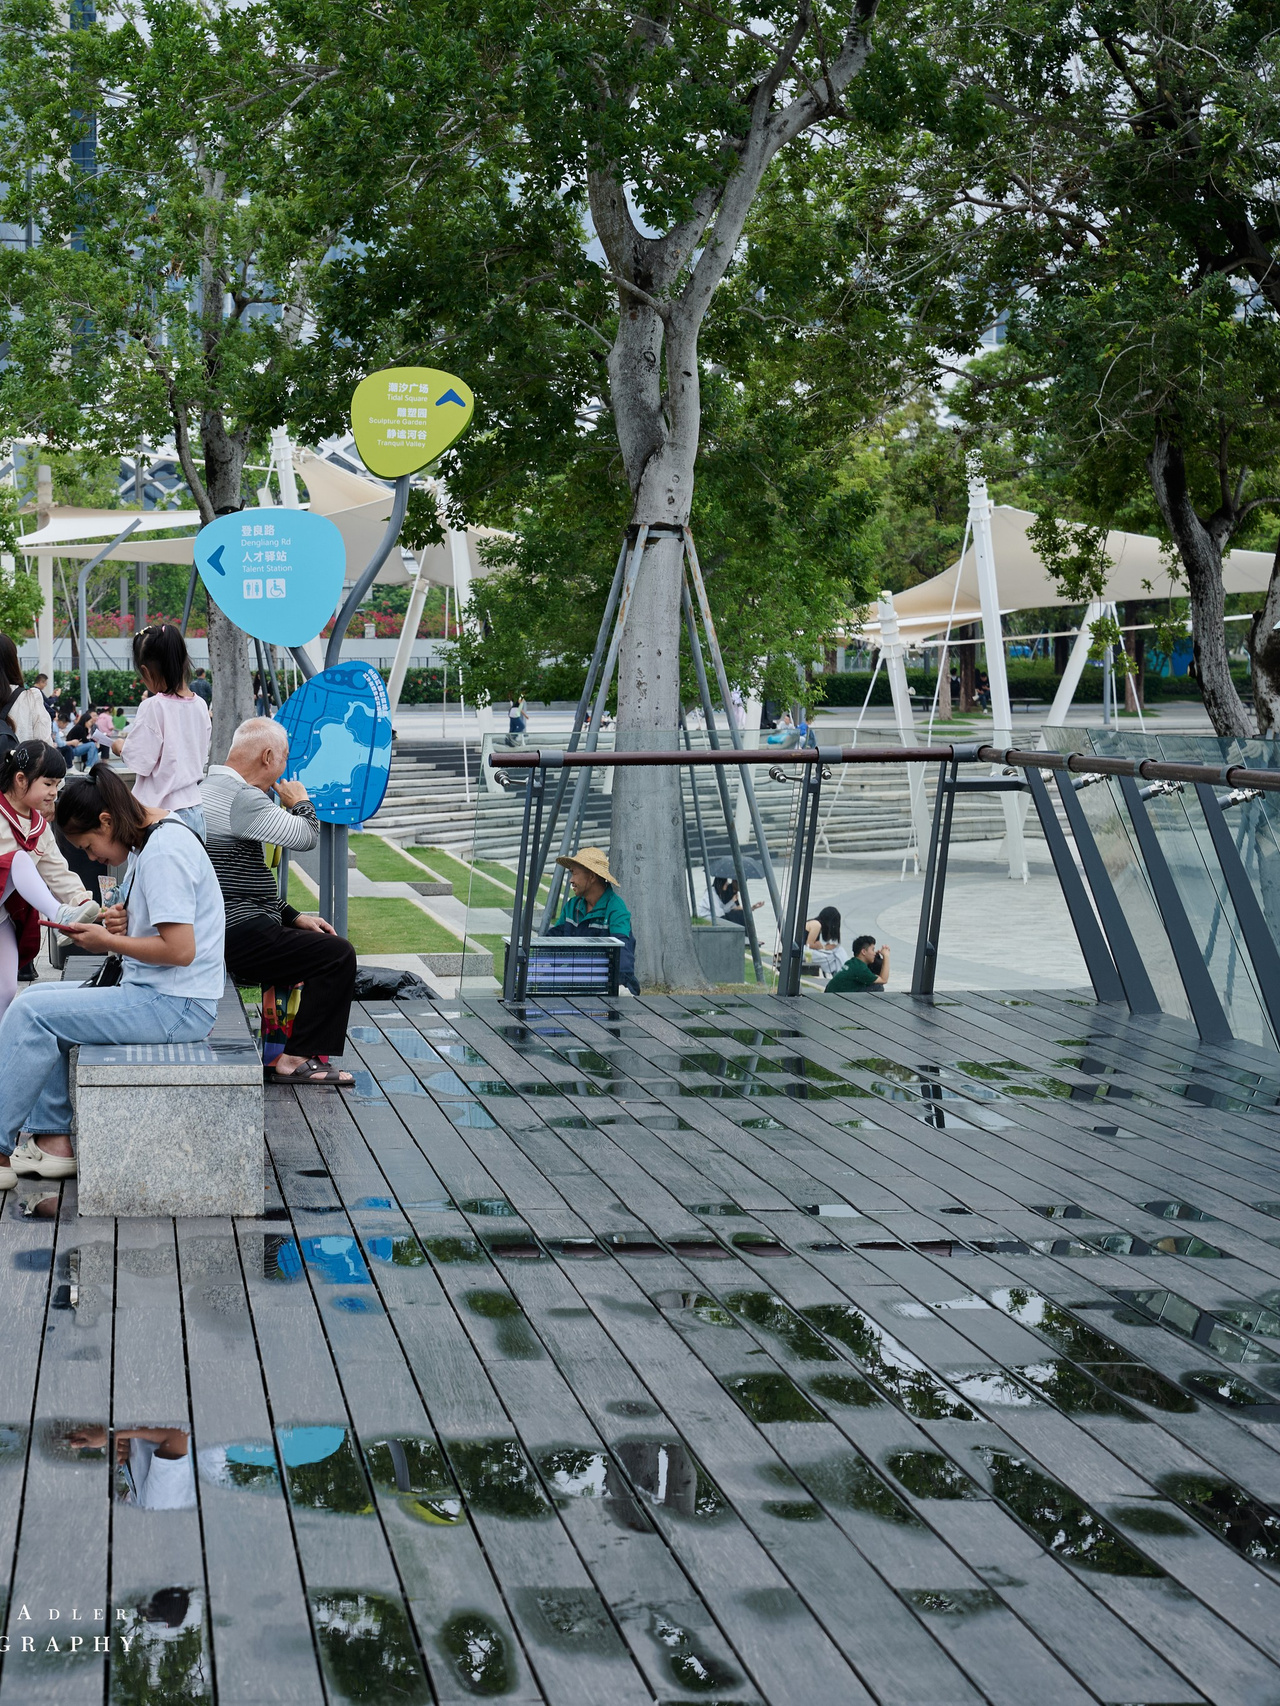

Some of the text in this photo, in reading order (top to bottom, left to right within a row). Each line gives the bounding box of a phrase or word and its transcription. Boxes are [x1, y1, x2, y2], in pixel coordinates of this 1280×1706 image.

[388, 382, 429, 394] 潮汐广场
[397, 407, 427, 418] 雕塑园
[368, 417, 427, 426] Sculpture Garden
[377, 439, 404, 447] Tranquil
[241, 524, 275, 537] 登良路
[241, 538, 279, 548] Dengliang
[266, 564, 293, 572] Station
